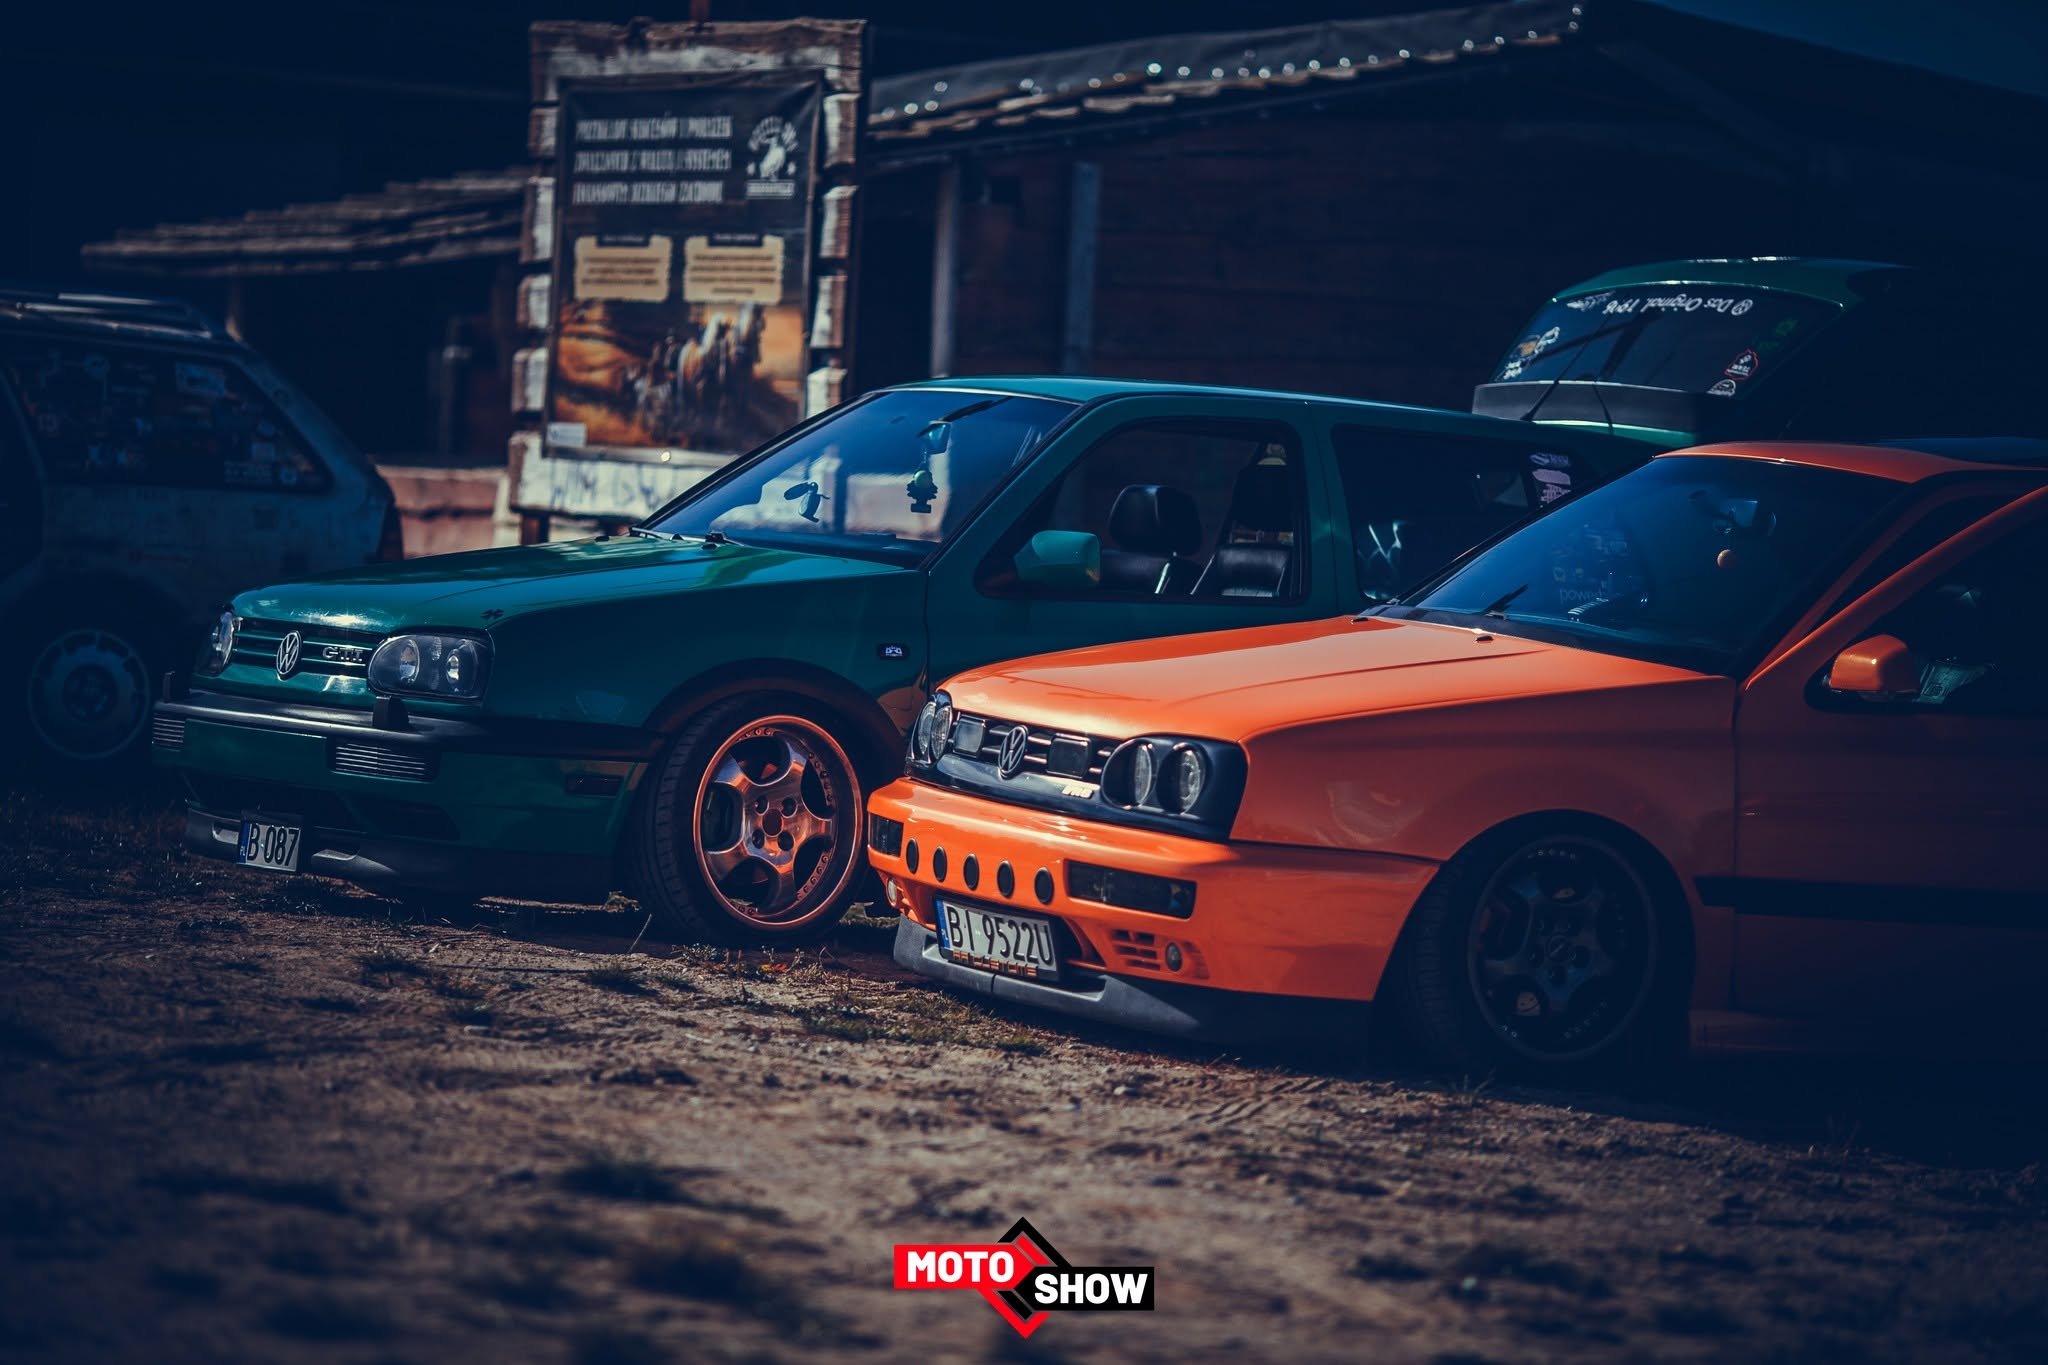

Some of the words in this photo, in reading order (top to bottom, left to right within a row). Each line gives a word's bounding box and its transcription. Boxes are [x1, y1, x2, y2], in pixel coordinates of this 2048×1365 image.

[1703, 298, 1734, 313] Das
[946, 906, 975, 951] BI
[982, 913, 1054, 966] 9522U
